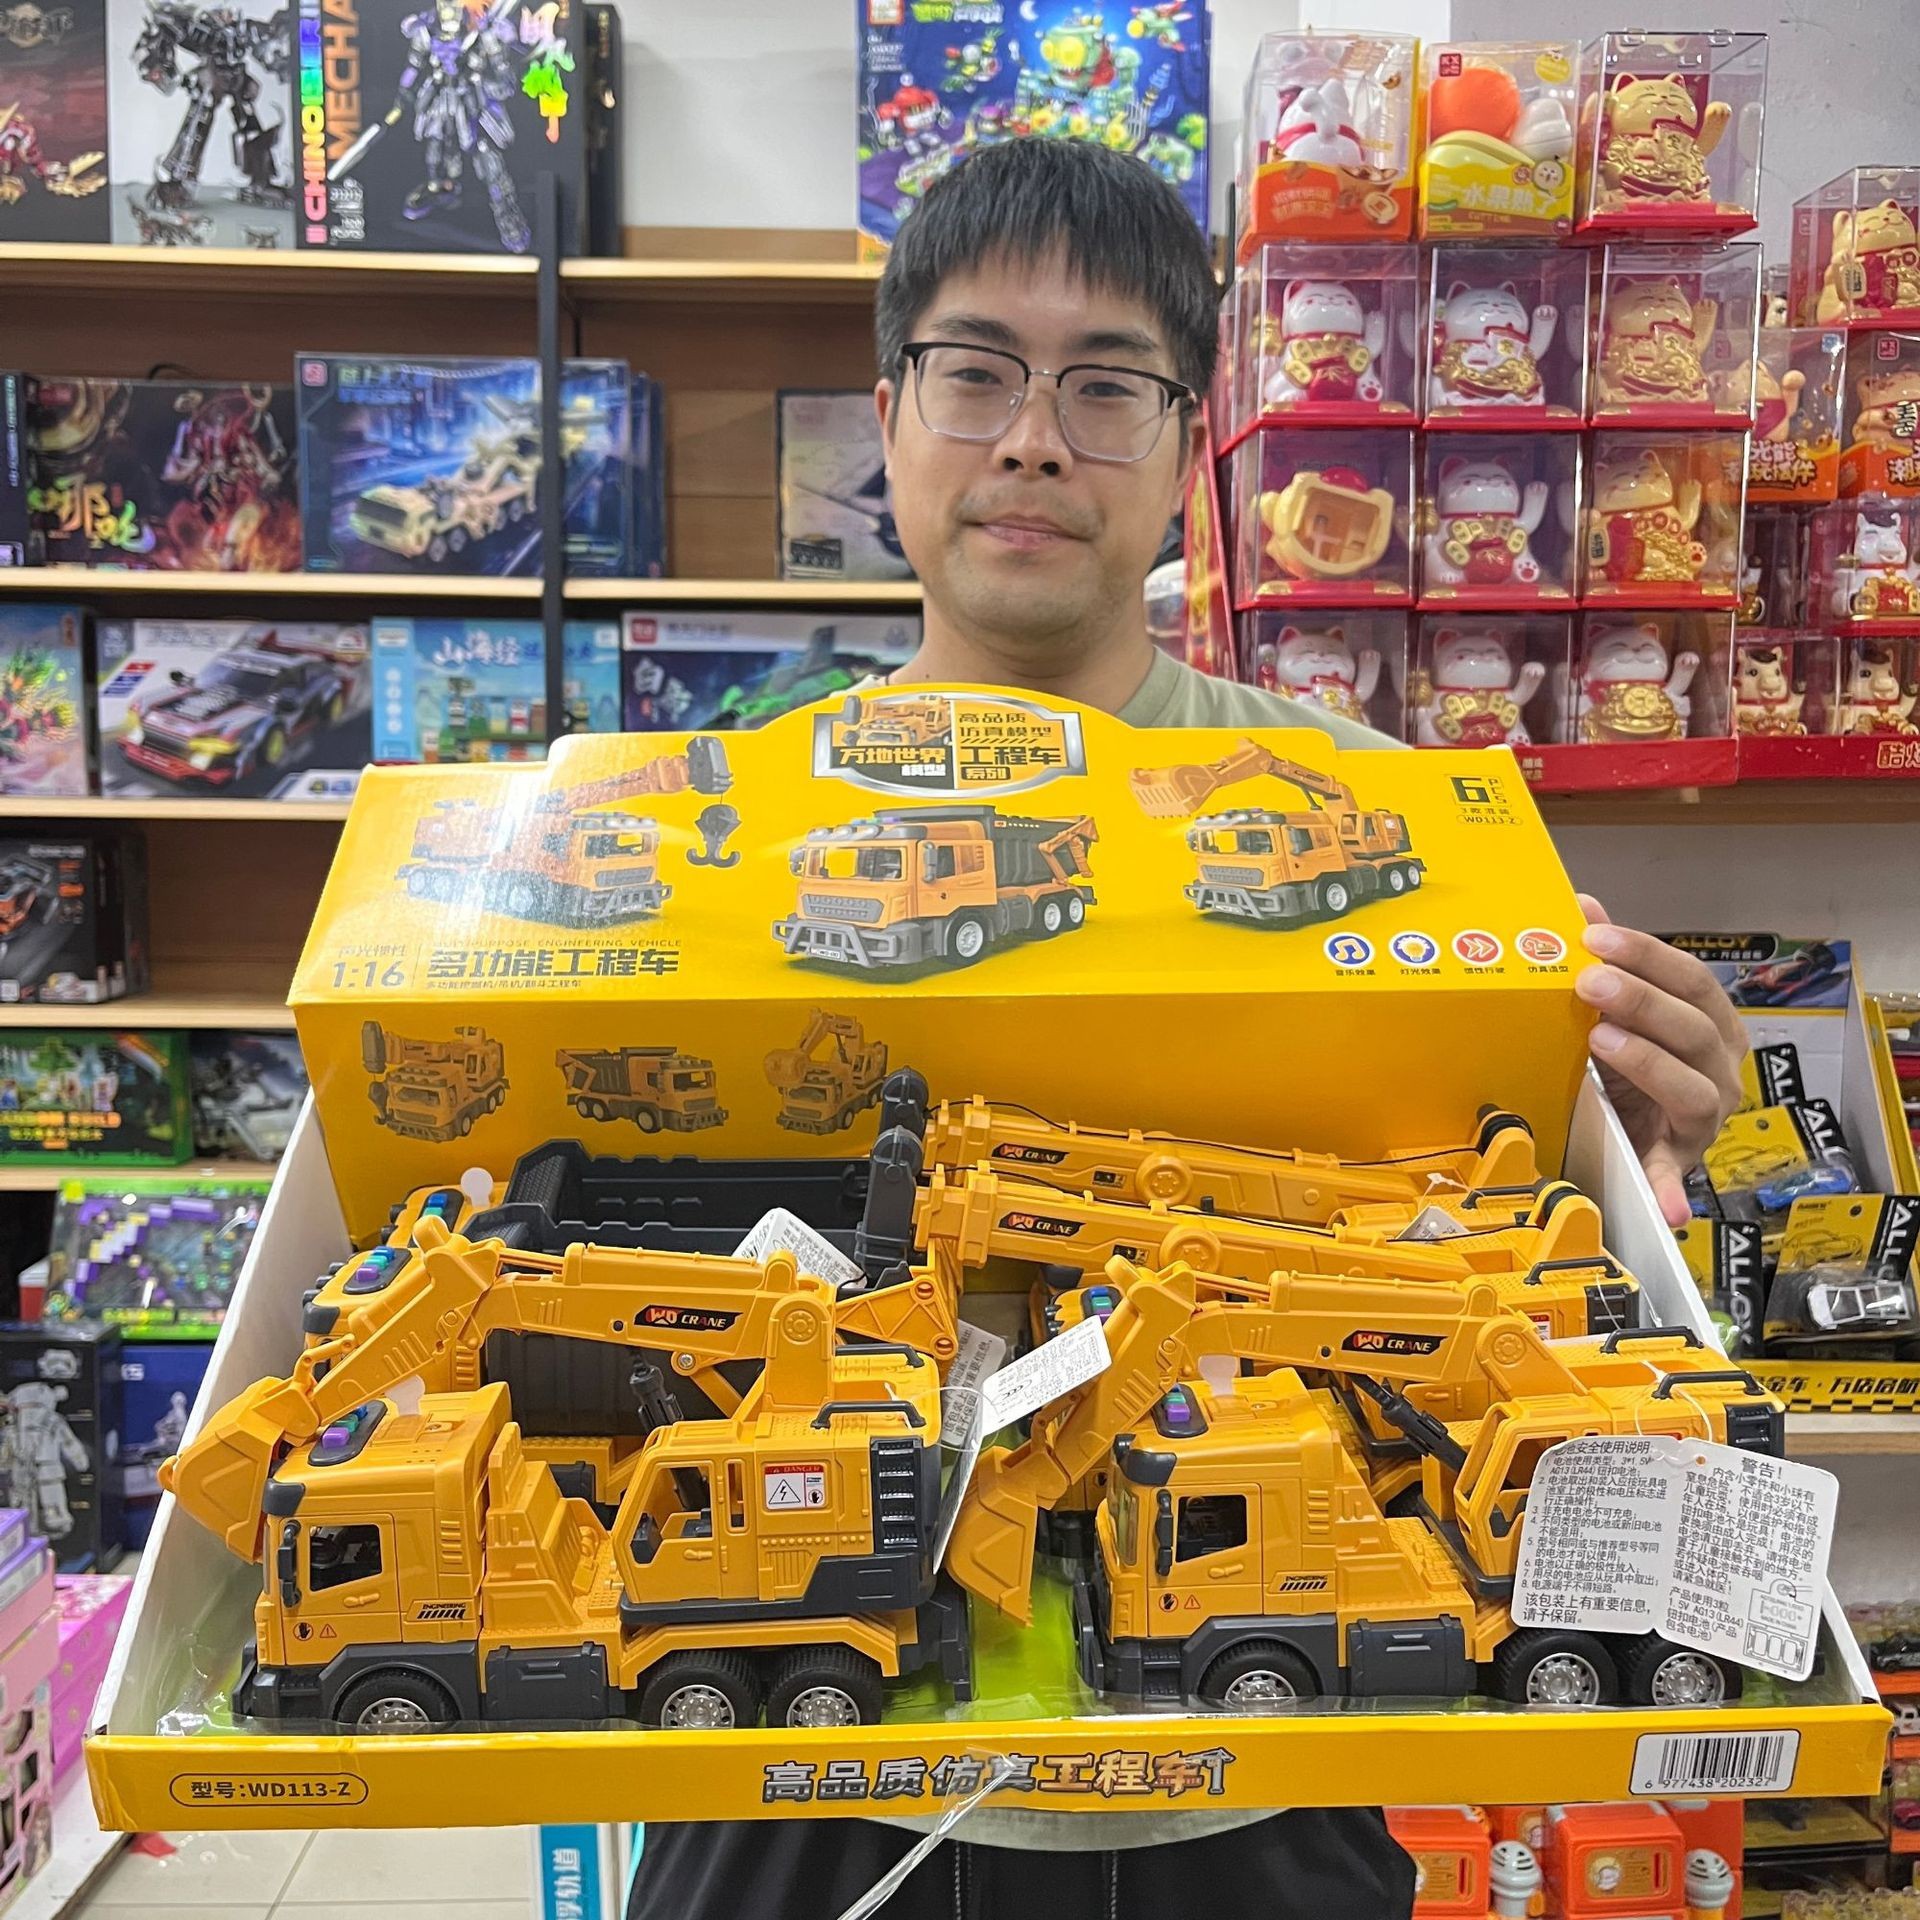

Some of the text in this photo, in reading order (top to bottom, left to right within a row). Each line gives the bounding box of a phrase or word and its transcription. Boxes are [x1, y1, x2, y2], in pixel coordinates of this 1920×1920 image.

[959, 713, 1026, 723] 高品质
[840, 748, 946, 764] 万地世界
[960, 746, 1062, 766] 工程车
[965, 768, 1008, 780] 系列
[1450, 776, 1490, 803] 6
[538, 939, 624, 947] ENGINEERING
[630, 939, 682, 947] VEHICLE
[426, 949, 680, 978] 多功能工程车
[333, 960, 406, 988] 1:16
[1025, 1151, 1060, 1163] CRANE
[1036, 1220, 1073, 1235] CRANE
[681, 1313, 727, 1328] CRANE
[1387, 1338, 1432, 1352] CRANE
[1645, 1777, 1772, 1789] 6 977438 202327
